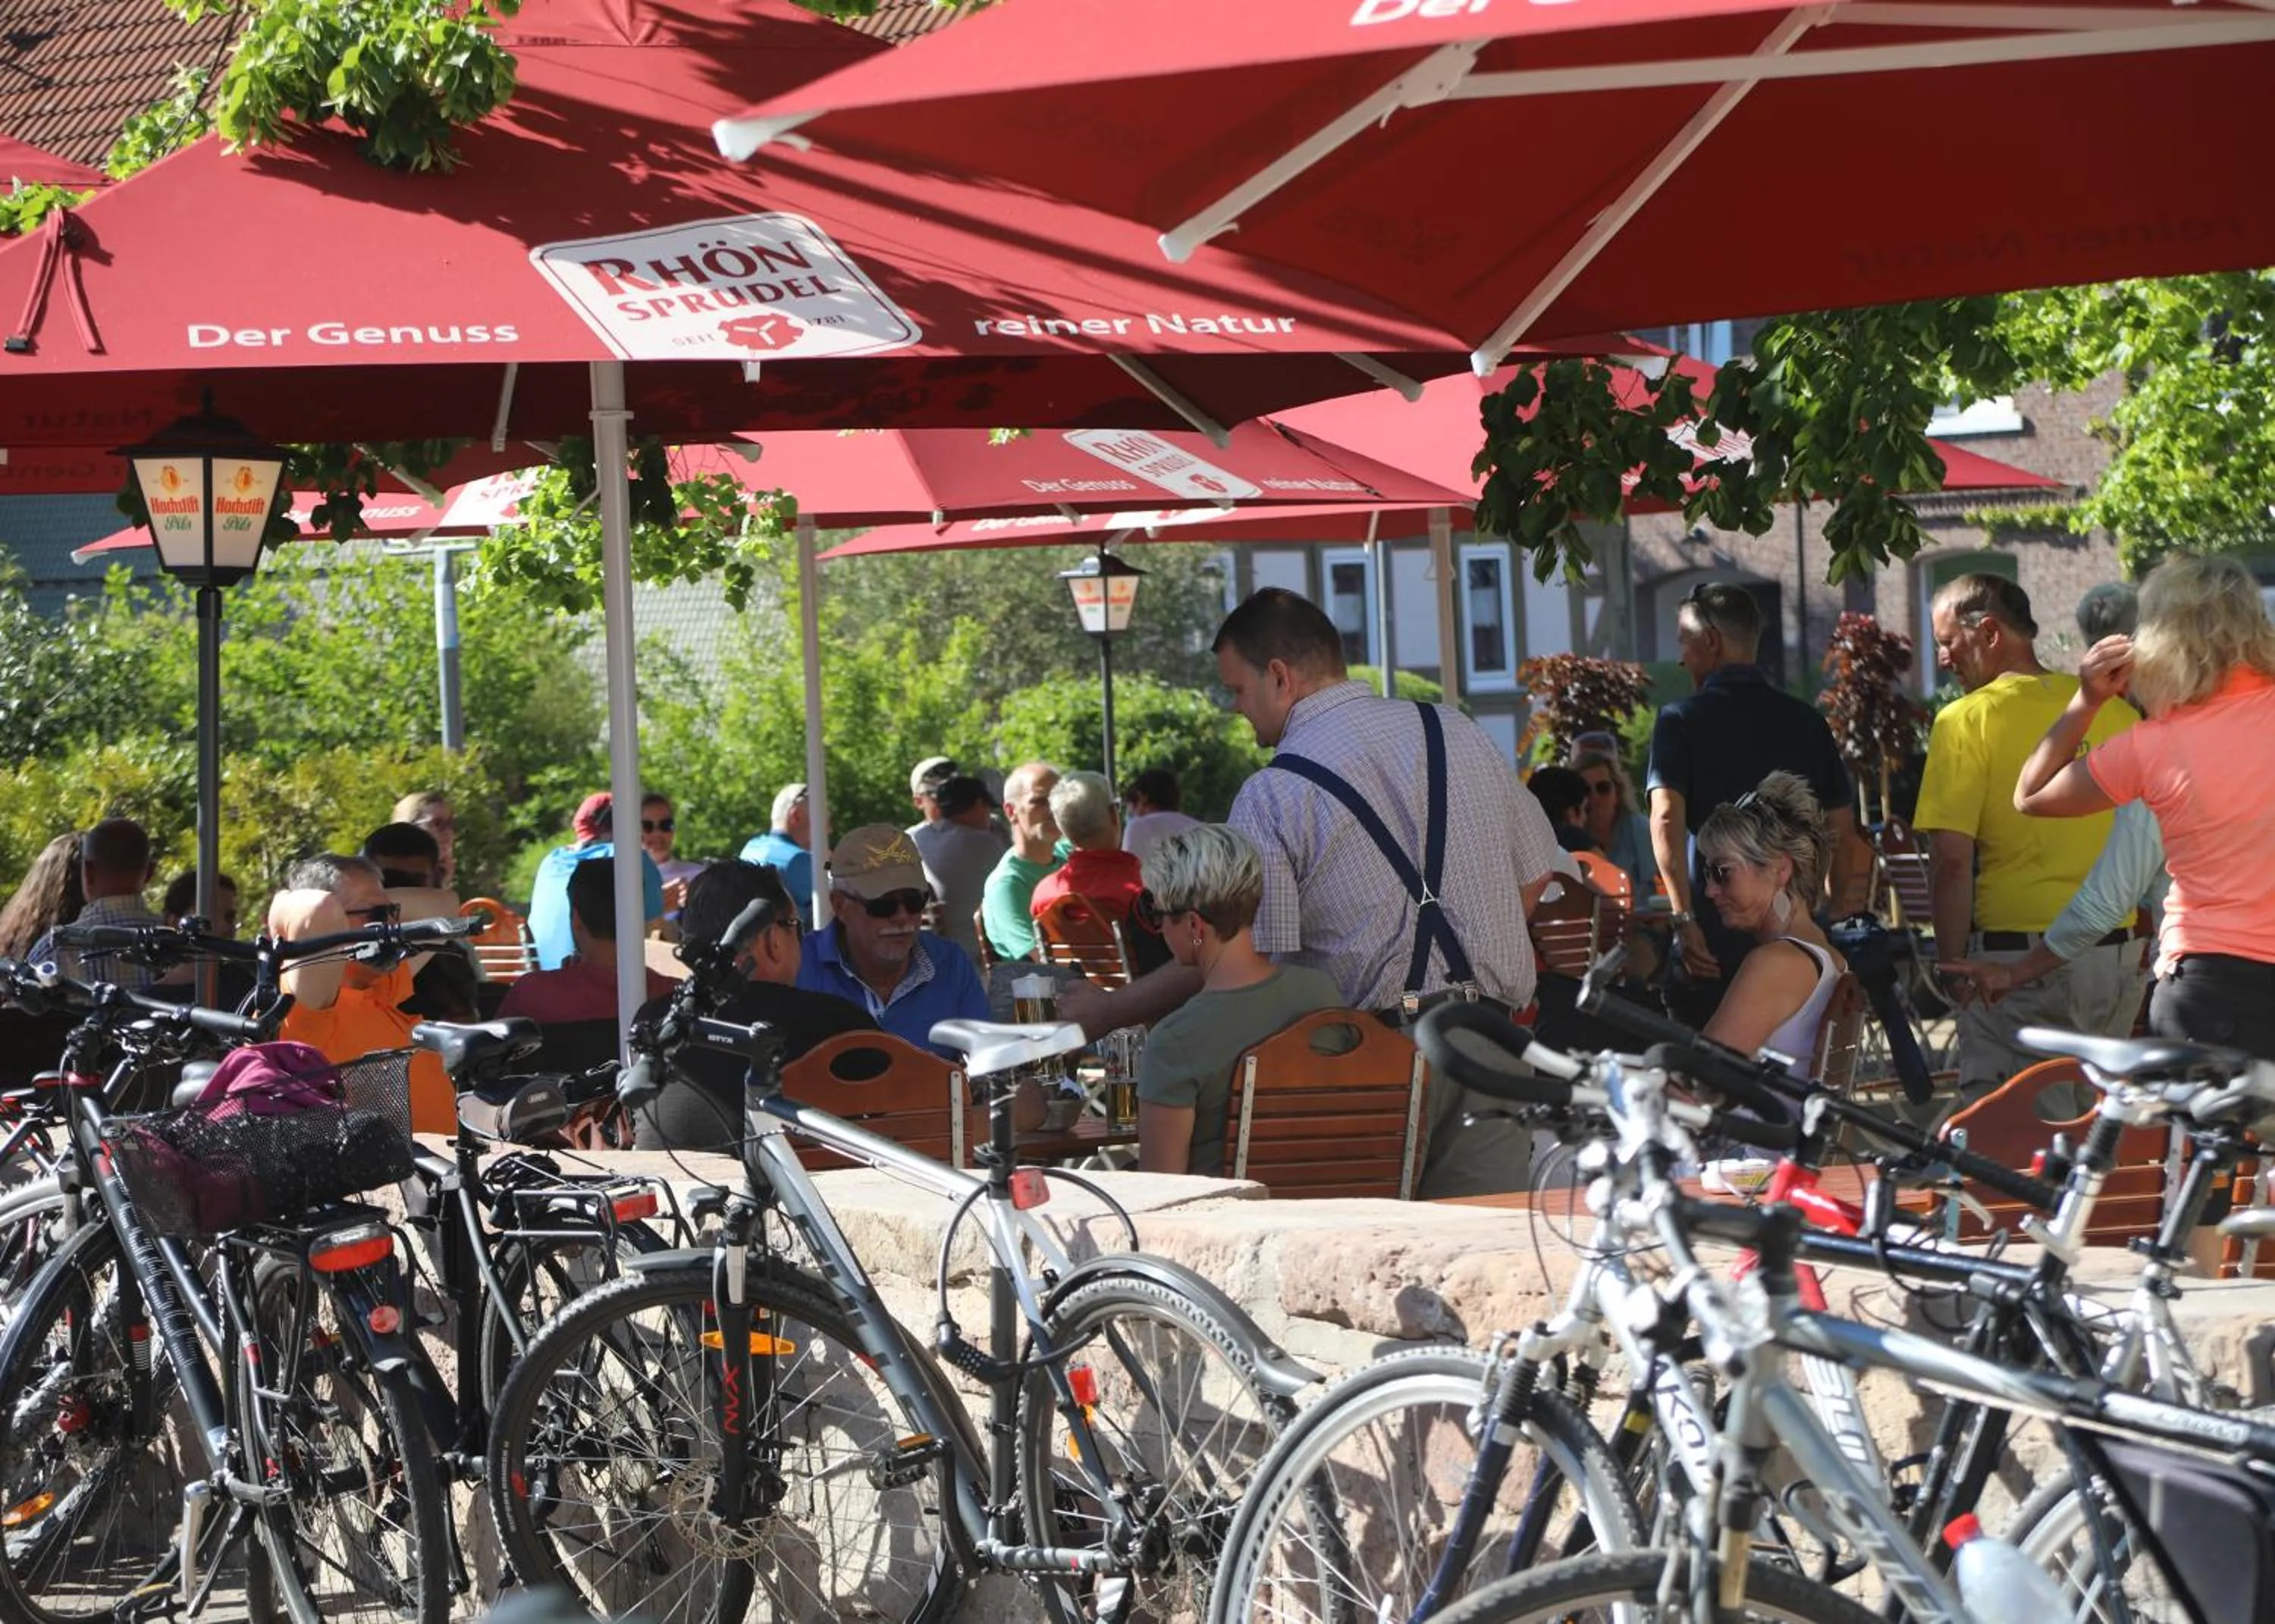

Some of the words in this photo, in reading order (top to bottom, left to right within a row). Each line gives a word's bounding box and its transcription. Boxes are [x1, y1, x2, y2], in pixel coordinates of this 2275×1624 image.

[581, 240, 814, 296] RHÖN
[617, 274, 842, 321] SPRUDEL
[187, 324, 291, 347] Der
[307, 322, 519, 344] Genuss
[974, 315, 1132, 336] reiner
[1144, 312, 1296, 334] Natur
